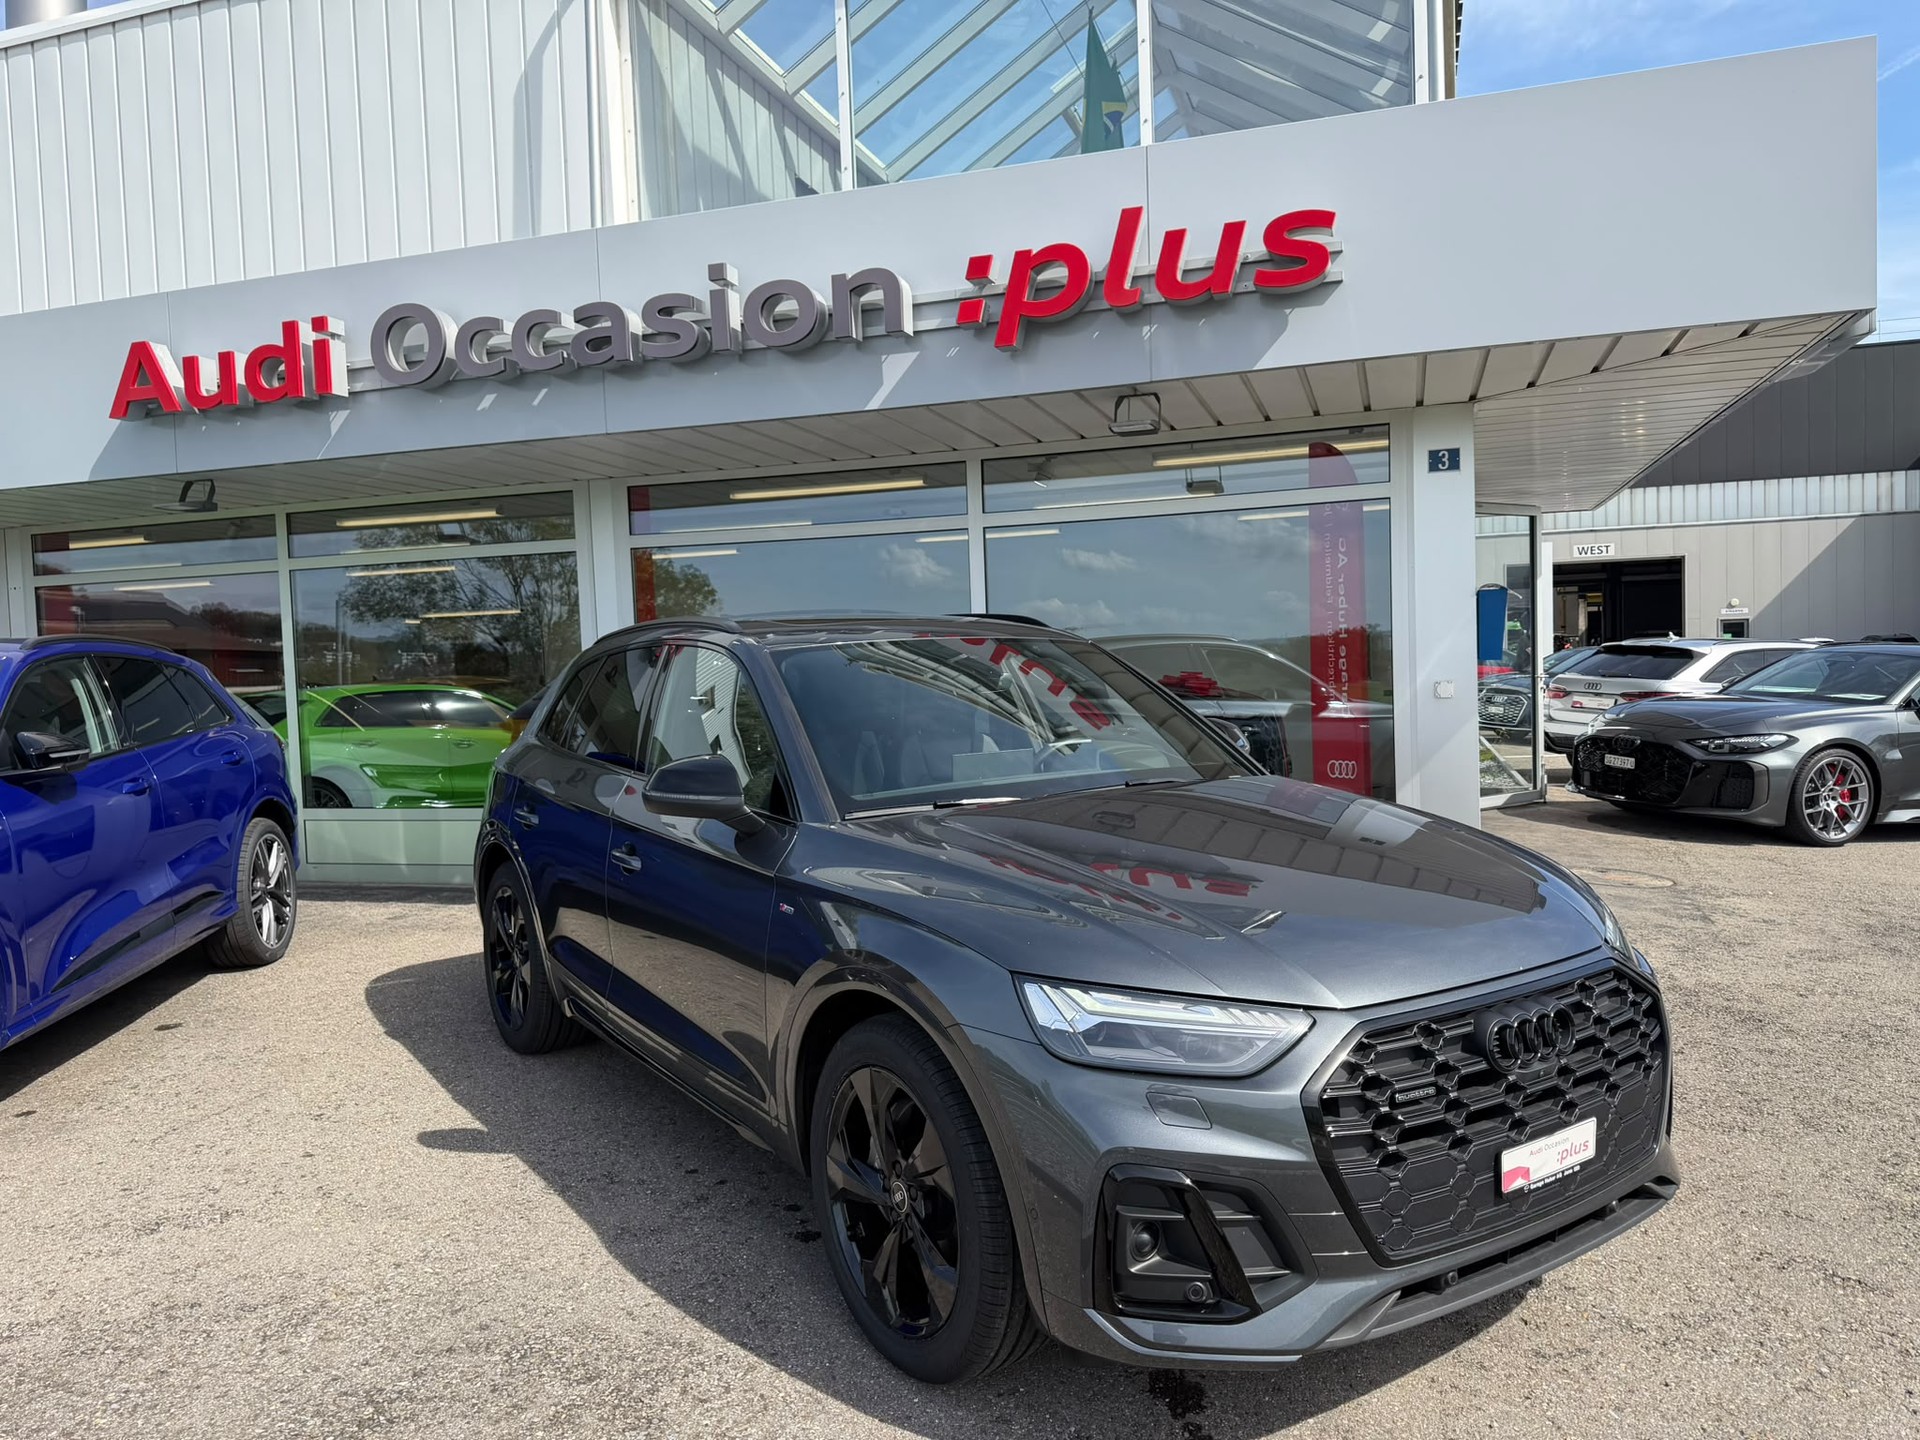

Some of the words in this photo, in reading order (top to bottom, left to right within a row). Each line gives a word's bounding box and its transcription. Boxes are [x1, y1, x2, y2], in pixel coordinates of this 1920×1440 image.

[109, 315, 340, 421] Audi
[371, 262, 912, 388] Occasion
[956, 205, 1338, 351] :plus
[1438, 450, 1449, 470] 3
[1576, 544, 1611, 556] WEST
[1529, 1147, 1544, 1157] Audi
[1544, 1137, 1570, 1152] Occasion
